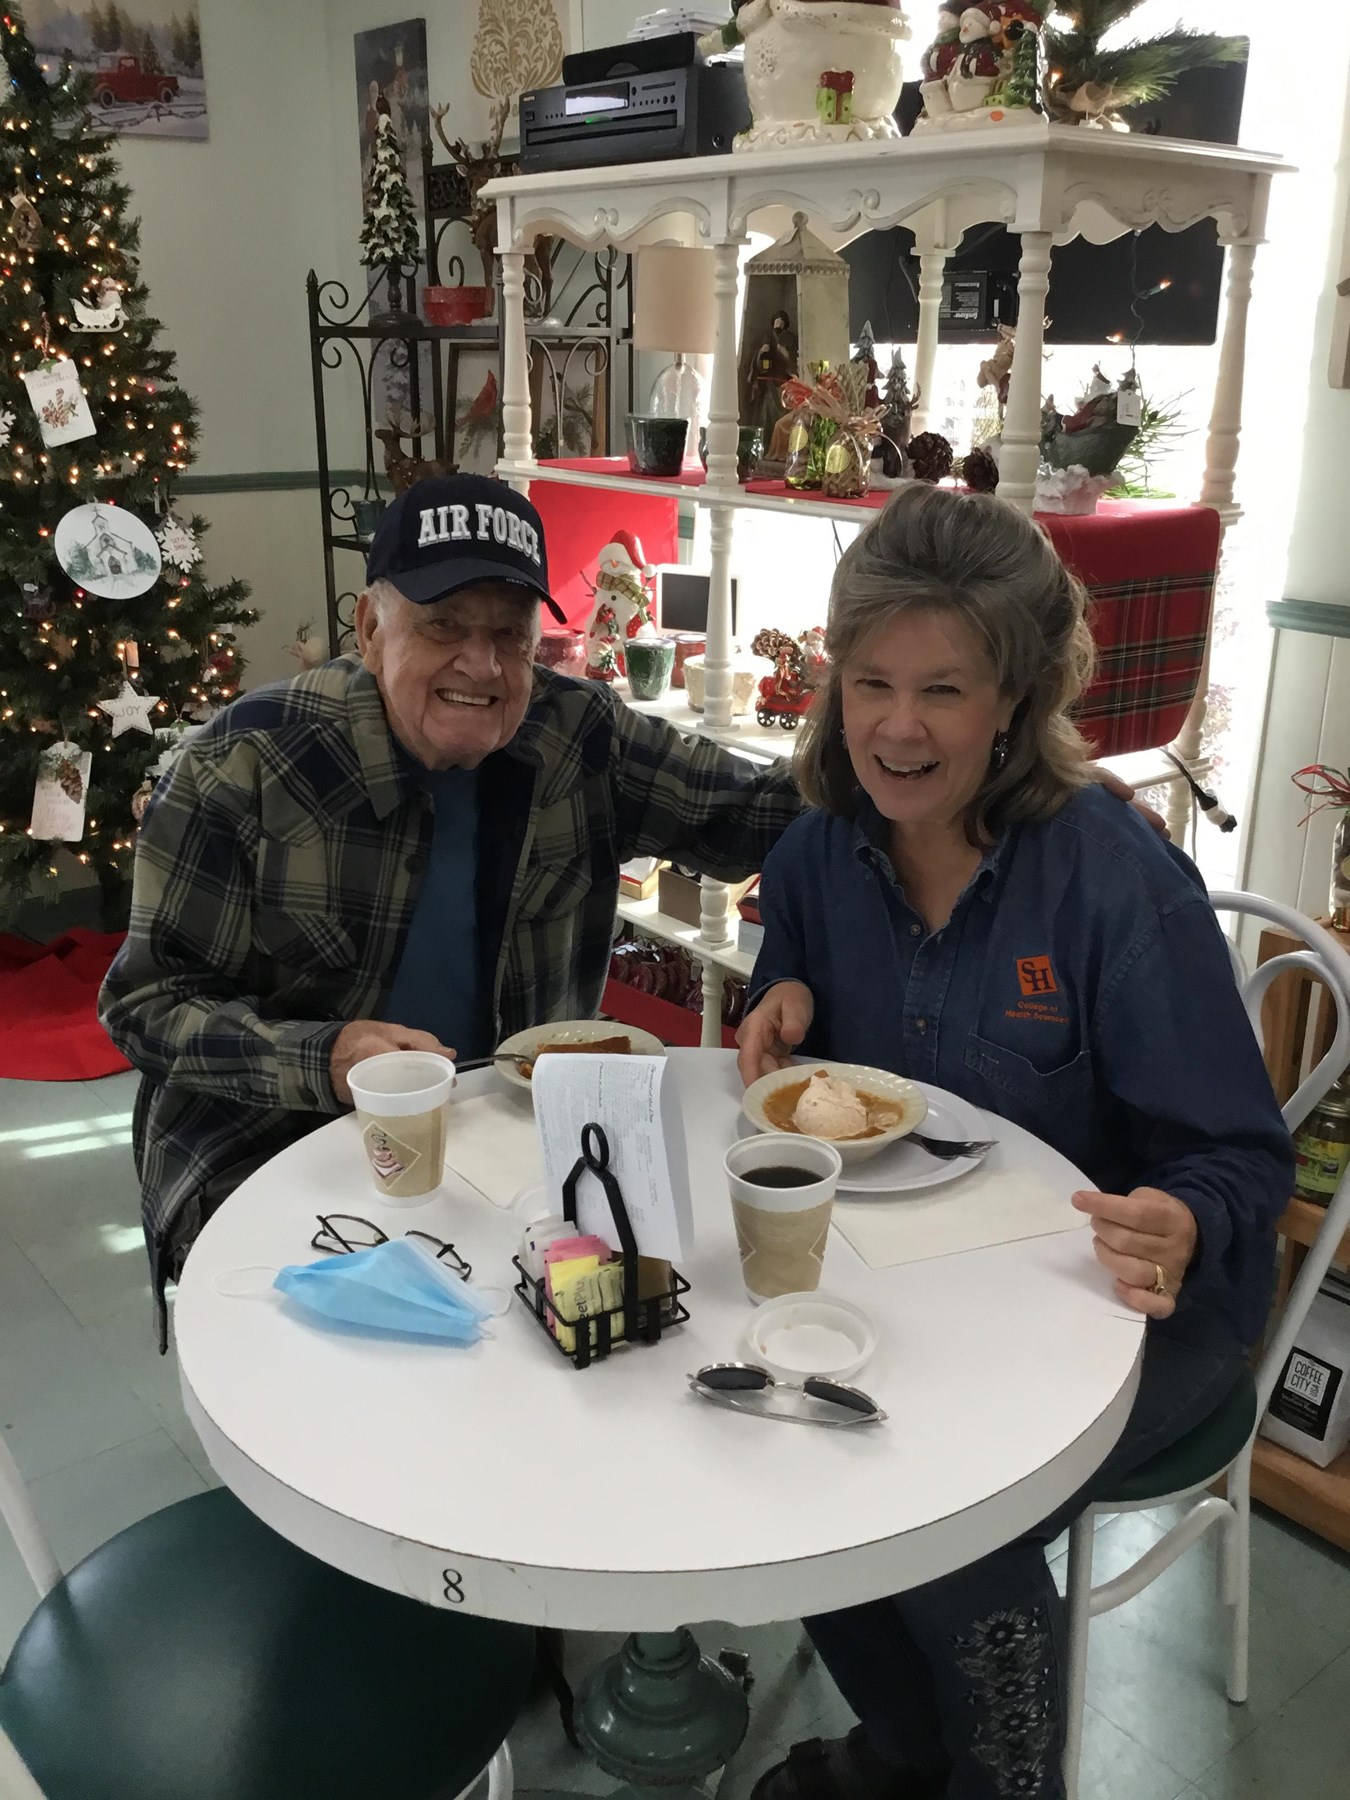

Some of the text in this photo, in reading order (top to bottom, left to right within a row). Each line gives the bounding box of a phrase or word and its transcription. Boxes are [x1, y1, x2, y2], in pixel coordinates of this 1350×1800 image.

[418, 503, 541, 567] AIR FORCE
[119, 705, 140, 717] JOY
[1021, 961, 1053, 992] SH
[1004, 1009, 1031, 1019] Health
[1017, 1000, 1048, 1012] College
[573, 1274, 589, 1320] eetPlu
[1290, 1373, 1312, 1393] CITY
[1294, 1360, 1324, 1386] COFFEE
[442, 1568, 465, 1604] 8
